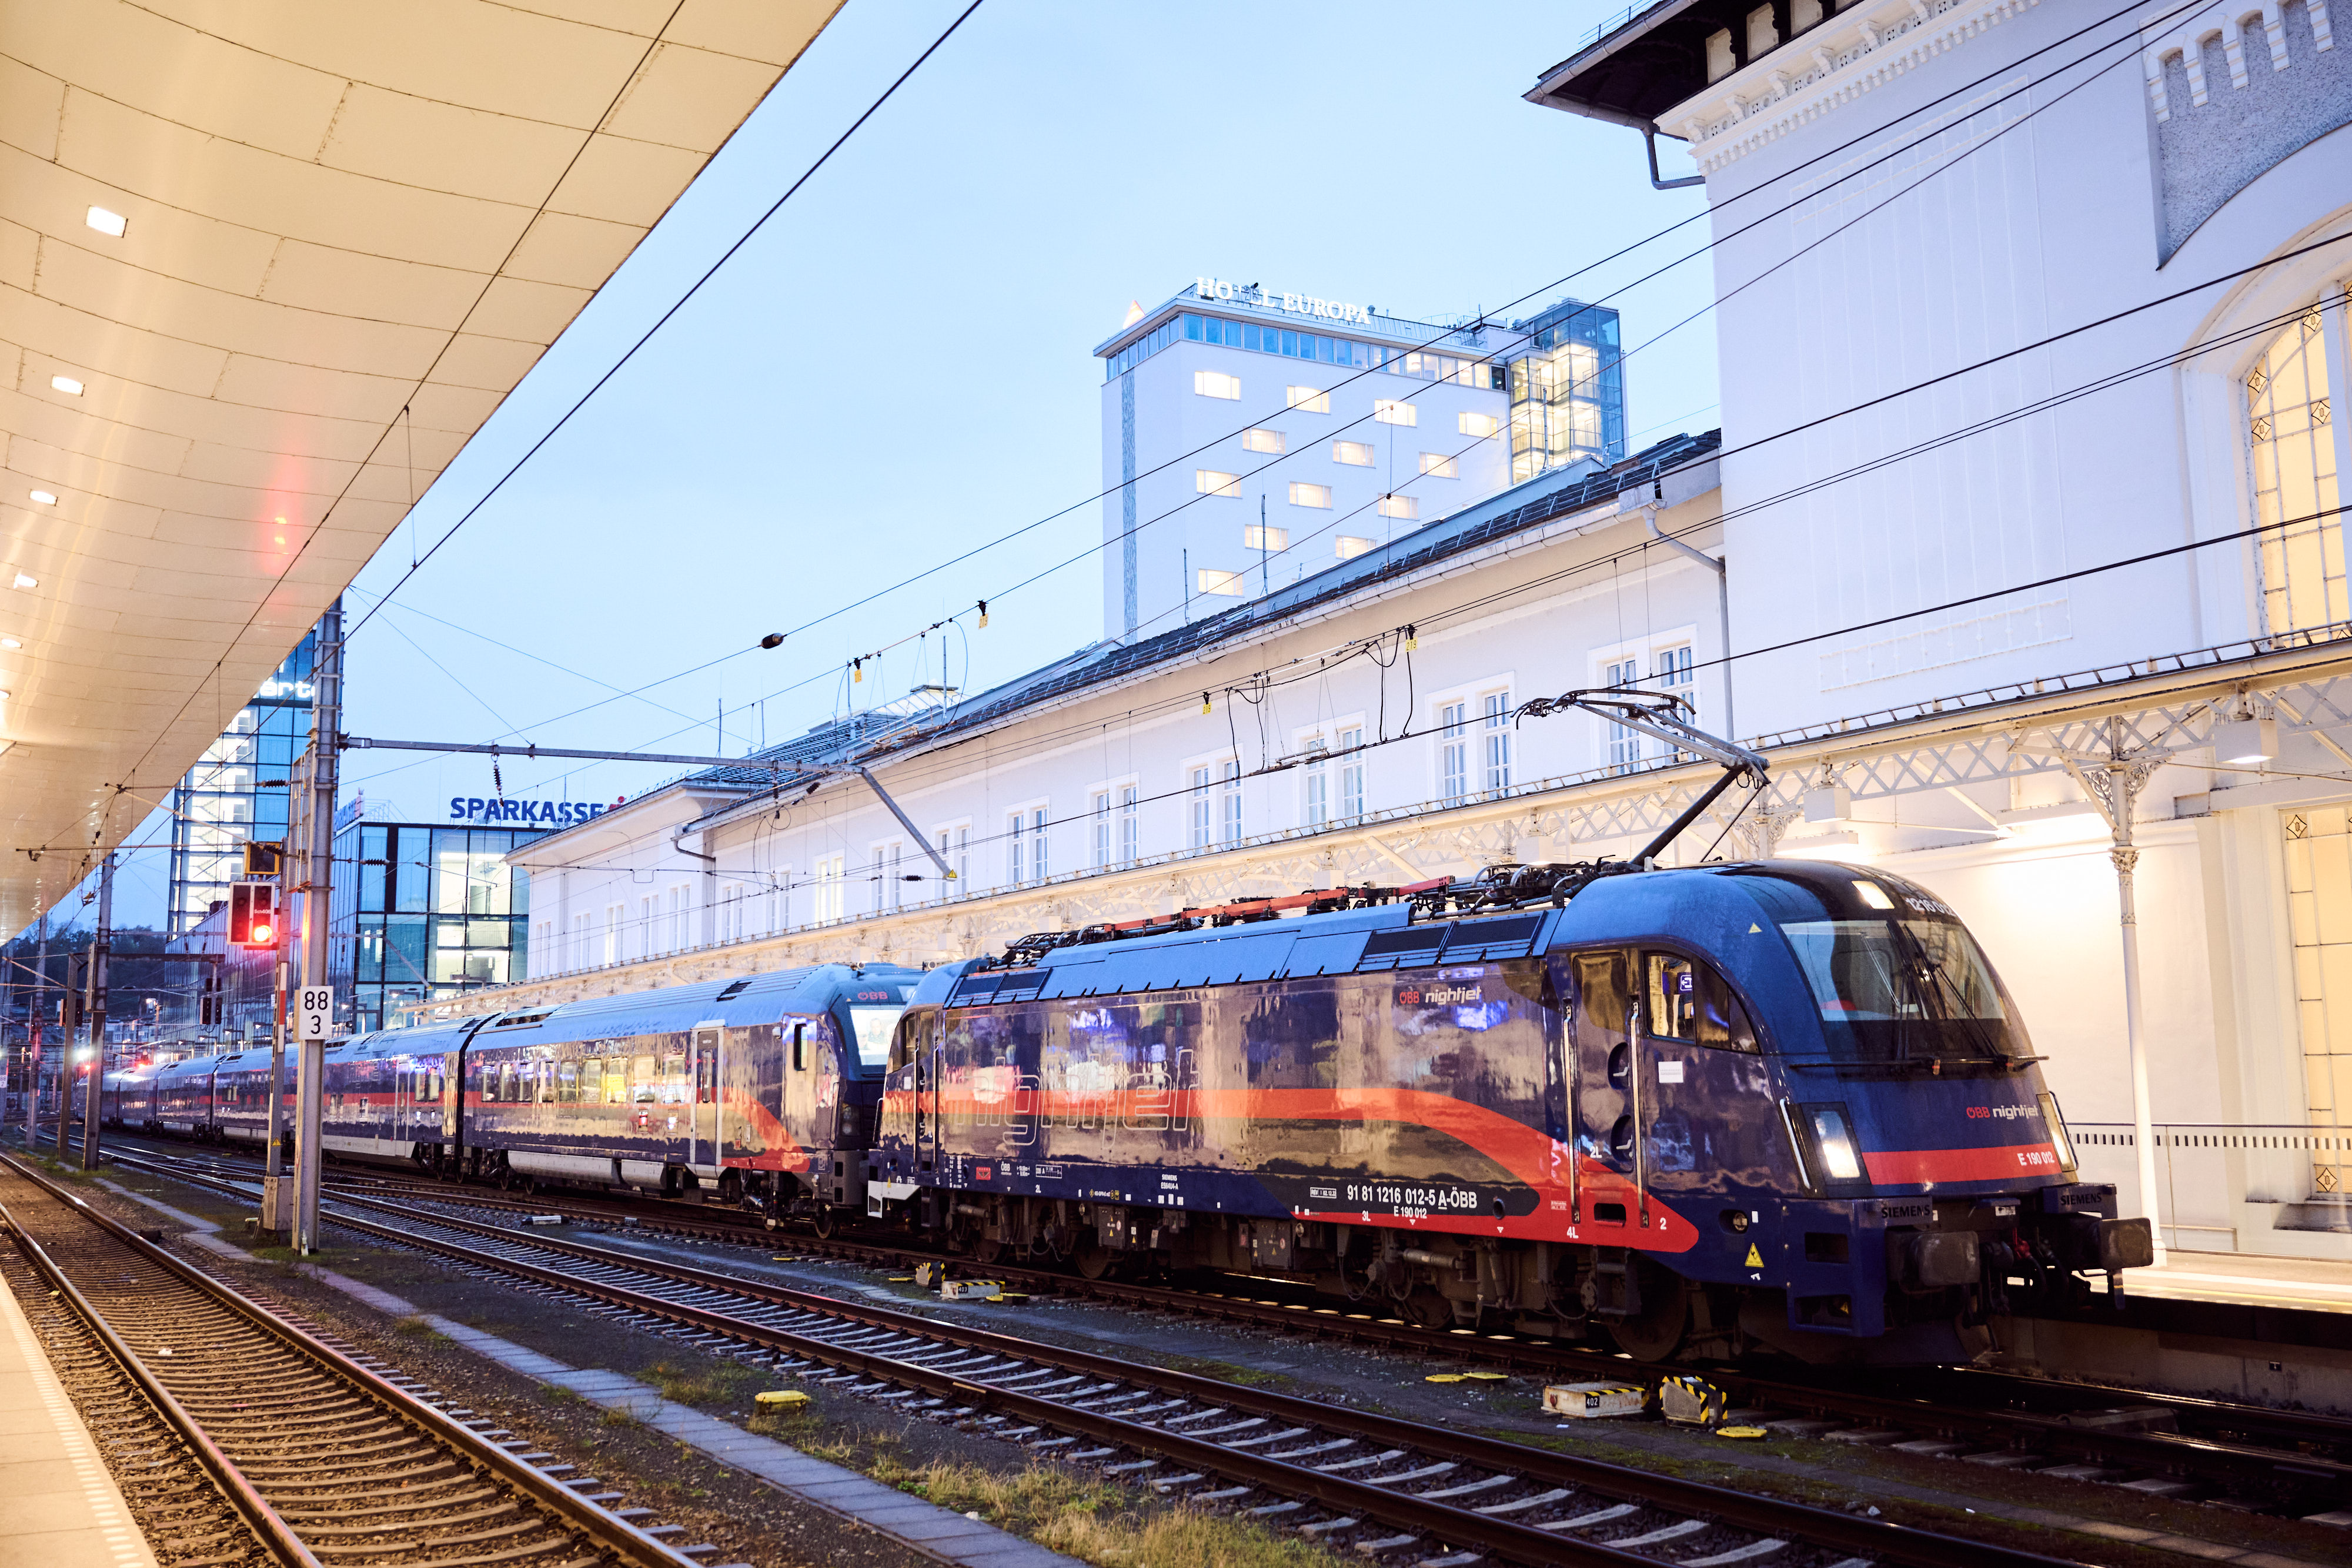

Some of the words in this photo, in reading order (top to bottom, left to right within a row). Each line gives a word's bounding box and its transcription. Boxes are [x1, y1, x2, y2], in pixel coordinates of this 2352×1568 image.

[1282, 292, 1371, 324] EUROPA
[1406, 640, 1416, 651] 219
[1905, 897, 1936, 912] 1216
[305, 991, 328, 1010] 88
[1425, 986, 1482, 1005] nightjet
[310, 1015, 320, 1034] 3
[1993, 1105, 2039, 1119] nightjet
[1590, 1146, 1602, 1158] 2L
[2017, 1153, 2027, 1166] E
[2026, 1152, 2042, 1165] 190
[2041, 1151, 2055, 1164] 012
[1347, 1184, 1358, 1201] 91
[1362, 1185, 1373, 1202] 81
[1377, 1186, 1401, 1203] 1216
[1405, 1188, 1436, 1206] 012-5
[1438, 1186, 1477, 1209] A-ÖBB
[2060, 1193, 2102, 1206] SIEMENS
[1362, 1211, 1371, 1222] 3L
[1394, 1206, 1399, 1217] E
[1401, 1206, 1414, 1218] 190
[1415, 1207, 1427, 1219] 012
[1882, 1205, 1931, 1219] SIEMENS
[1660, 1218, 1667, 1230] 2
[1566, 1226, 1579, 1239] 4L
[1586, 1397, 1598, 1406] 402
